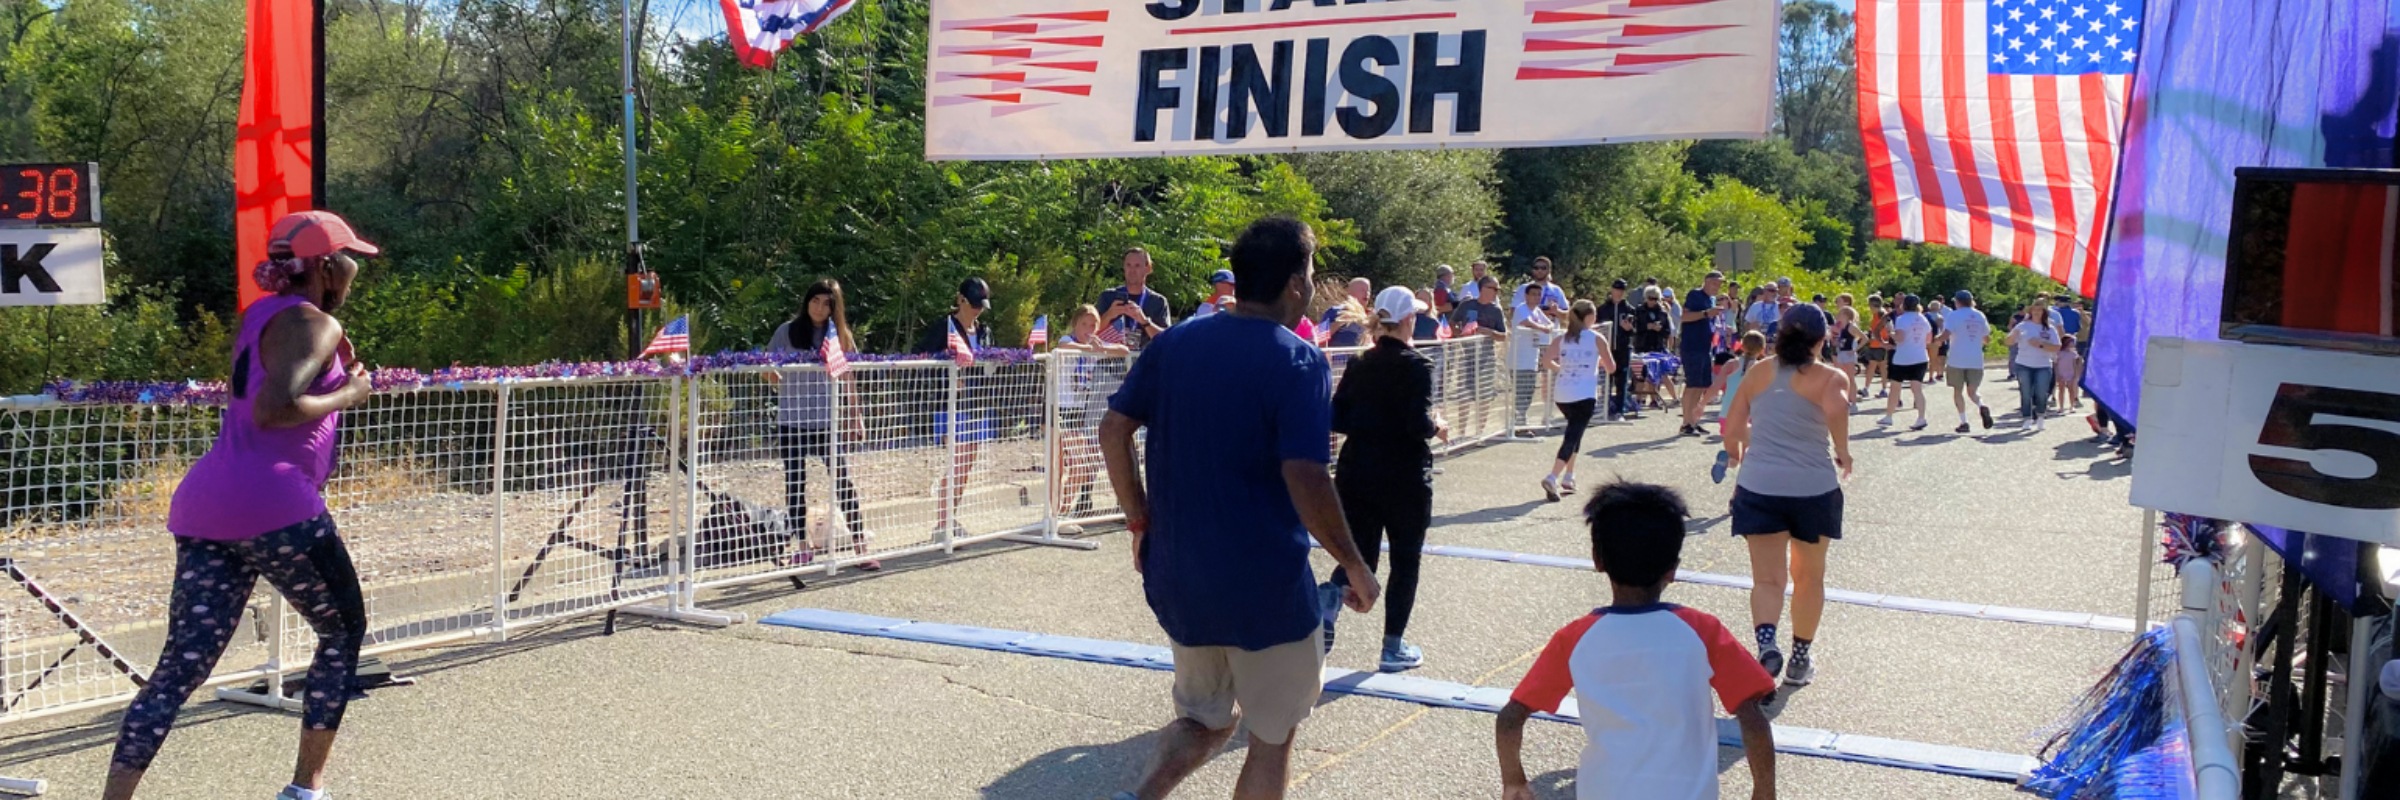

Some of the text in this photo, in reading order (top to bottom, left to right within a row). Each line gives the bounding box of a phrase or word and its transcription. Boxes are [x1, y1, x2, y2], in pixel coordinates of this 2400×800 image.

[1134, 29, 1487, 142] FINISH
[0, 243, 63, 294] K
[2248, 382, 2400, 510] 5
